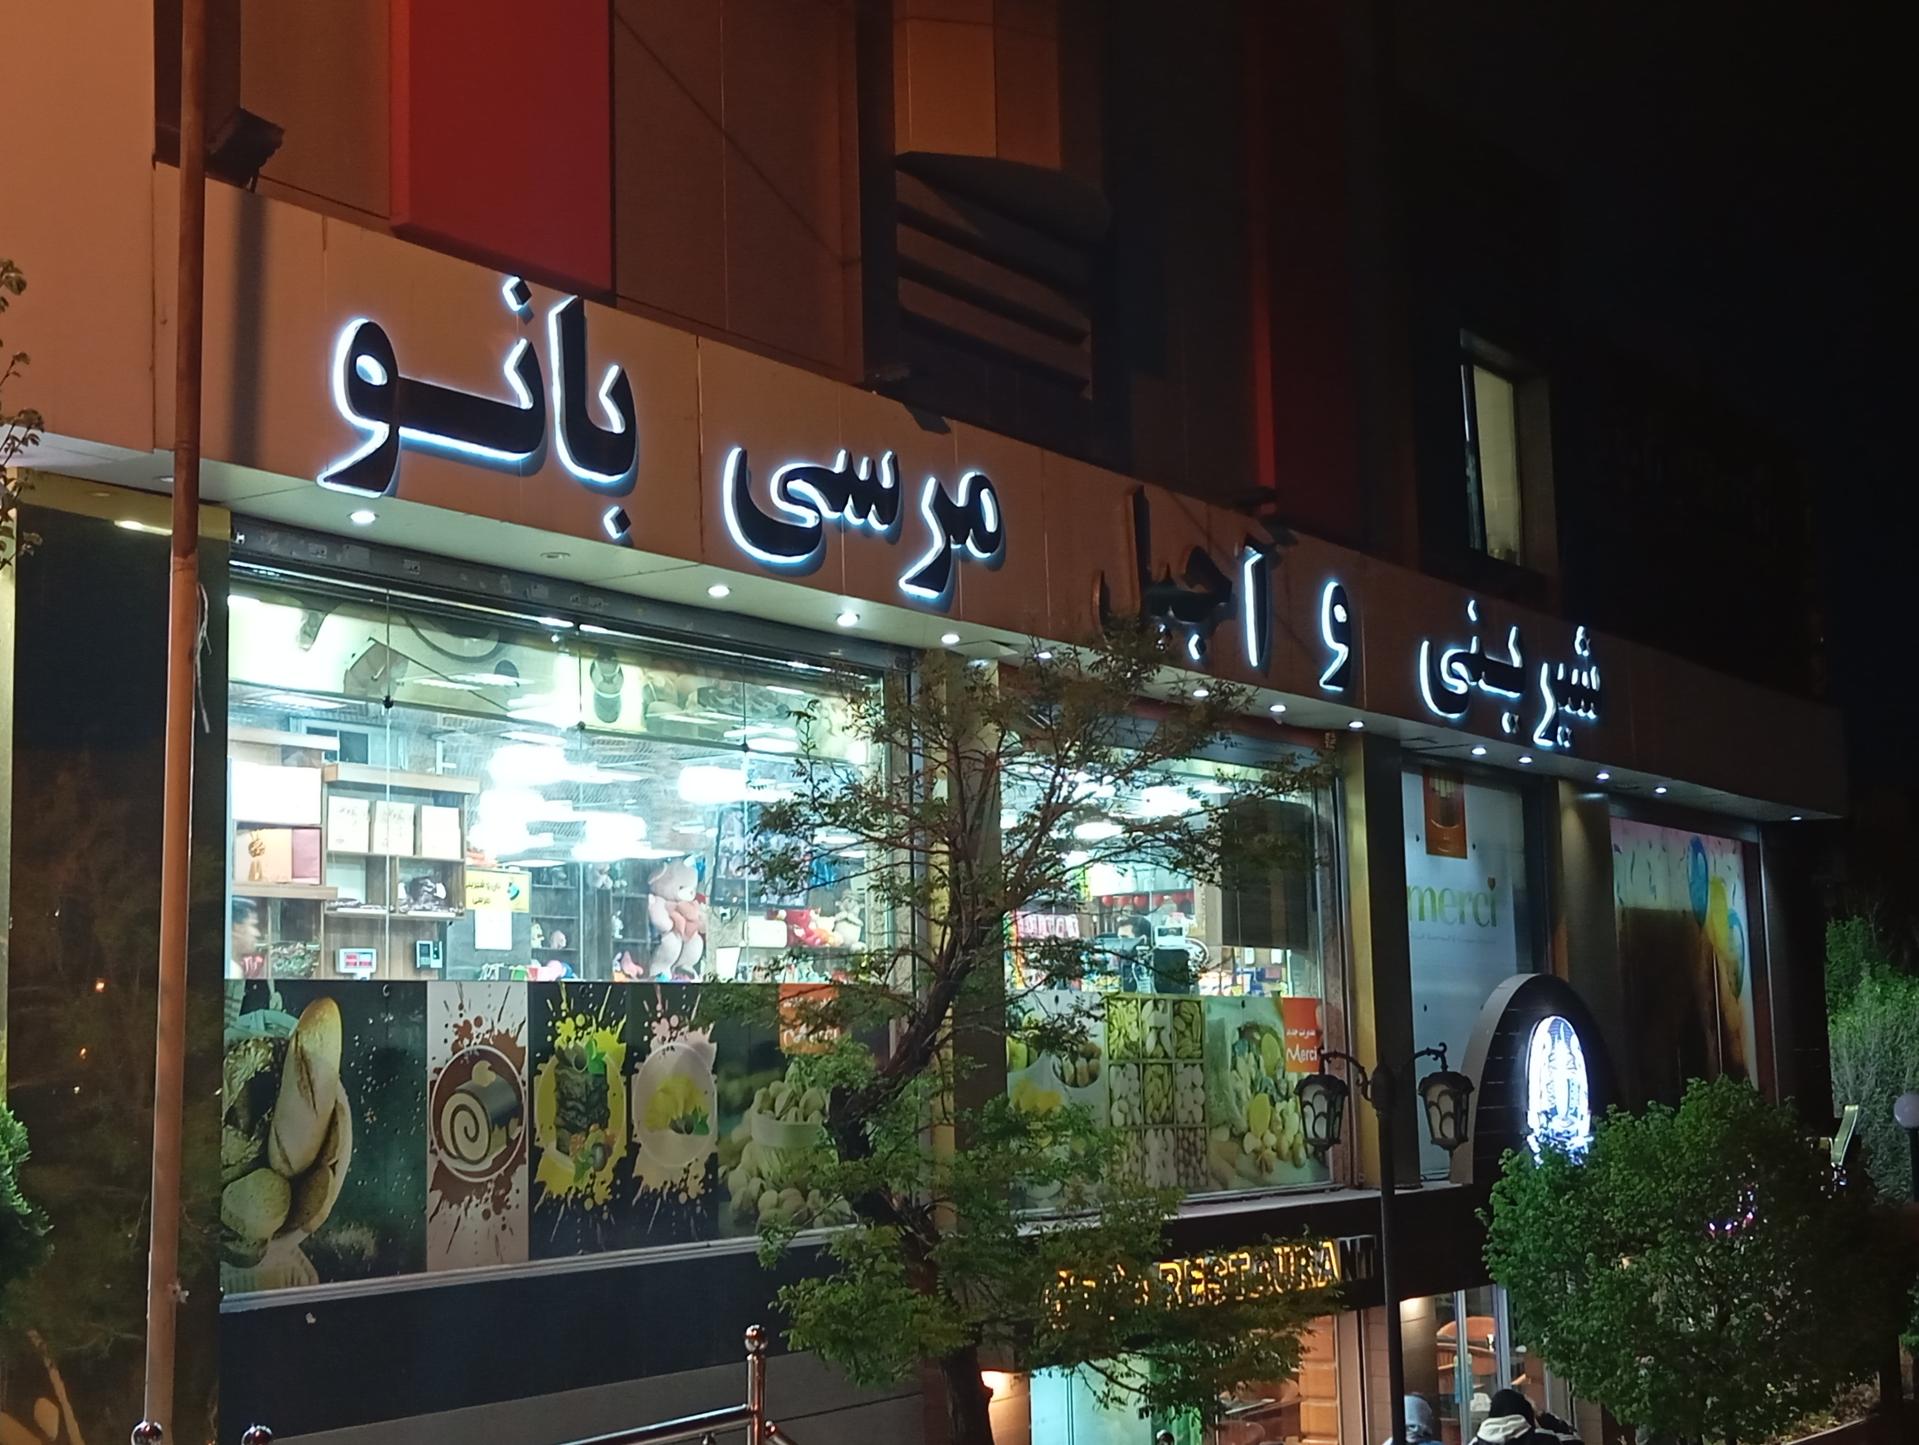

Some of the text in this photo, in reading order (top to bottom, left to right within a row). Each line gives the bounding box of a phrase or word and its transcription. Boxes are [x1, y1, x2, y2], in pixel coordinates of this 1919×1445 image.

[314, 274, 638, 542] بانو
[722, 446, 1002, 602] مرسی
[1318, 578, 1352, 693] و
[1406, 876, 1498, 929] merci
[1286, 1043, 1318, 1064] Merci
